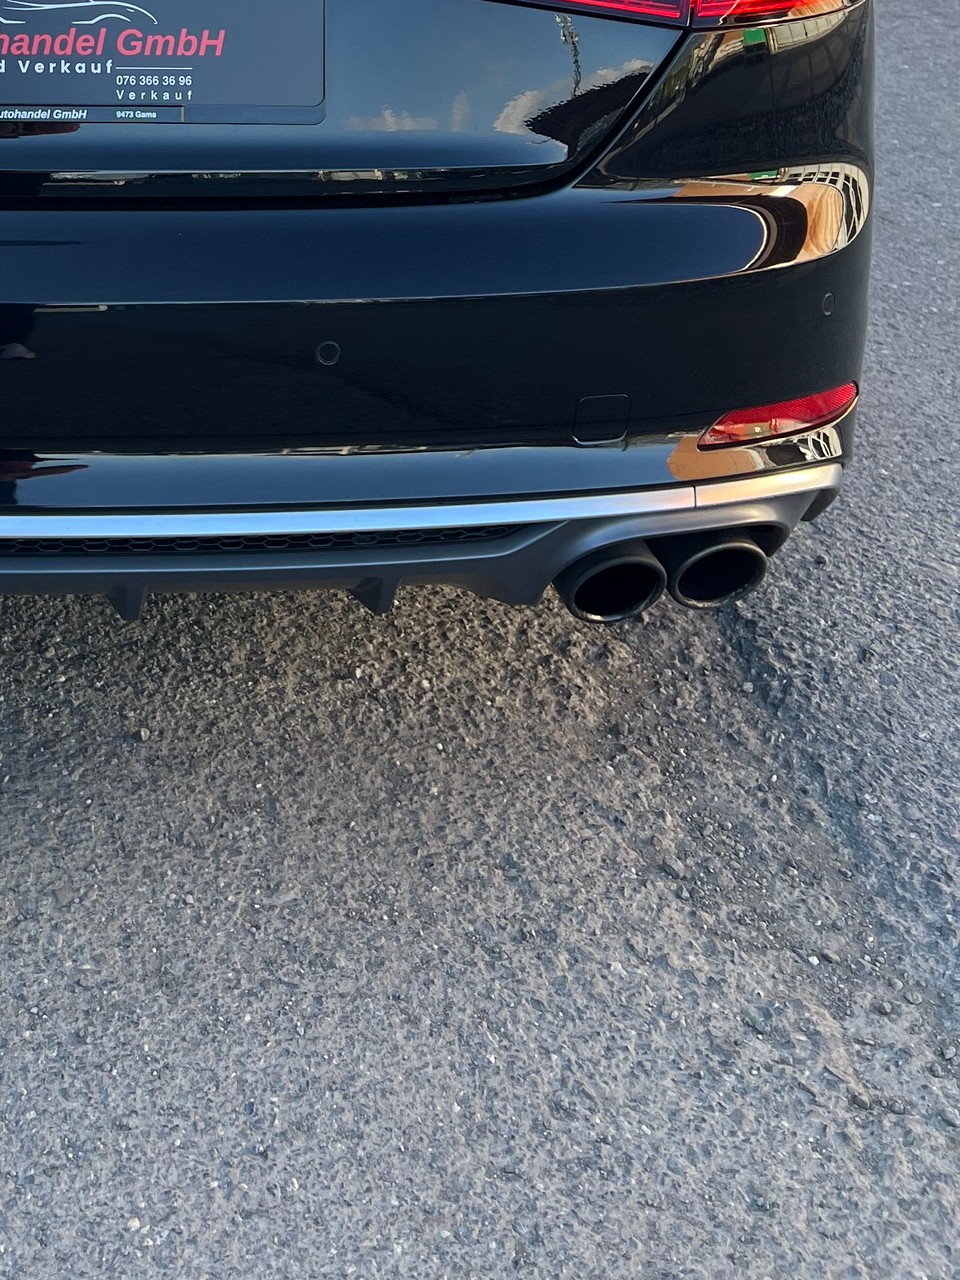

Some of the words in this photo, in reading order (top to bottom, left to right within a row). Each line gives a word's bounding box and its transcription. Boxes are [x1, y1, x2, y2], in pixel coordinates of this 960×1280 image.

[116, 28, 225, 56] GmbH
[18, 60, 113, 73] Verkauf
[116, 75, 136, 86] 076
[139, 75, 159, 86] 366
[162, 75, 176, 86] 36
[178, 75, 192, 86] 96
[116, 89, 193, 100] Verkauf
[53, 109, 87, 119] GmbH
[116, 110, 134, 118] 9473
[136, 110, 156, 118] Gams
